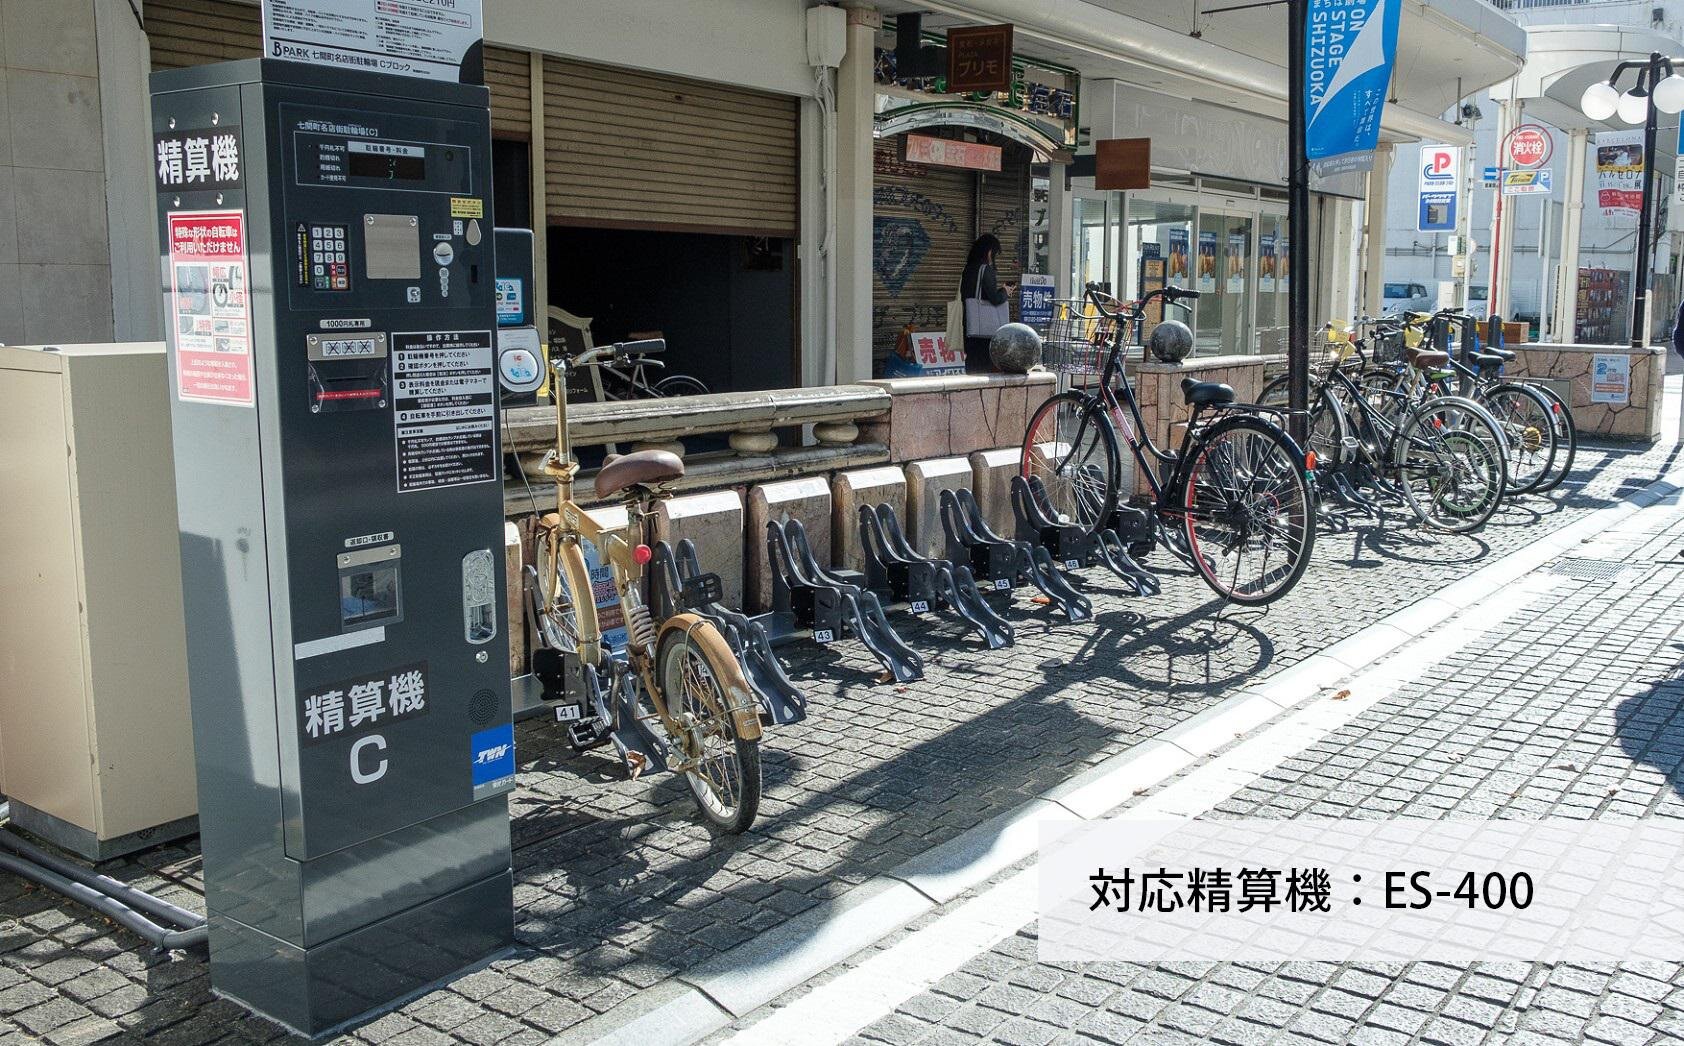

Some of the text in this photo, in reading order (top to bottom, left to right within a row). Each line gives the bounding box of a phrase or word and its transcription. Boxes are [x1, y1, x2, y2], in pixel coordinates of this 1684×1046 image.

[1350, 8, 1366, 31] ON
[1329, 10, 1346, 68] STAGE
[380, 60, 411, 72] Cブロック
[1310, 12, 1328, 105] SHIZUOKA
[1513, 141, 1543, 155] 消火栓
[158, 135, 240, 184] 精算機
[174, 241, 241, 254] ご利用いただけません
[918, 336, 967, 364] 売物
[997, 579, 1008, 588] 45
[914, 602, 926, 610] 44
[818, 631, 831, 640] 43
[304, 669, 426, 738] 精算機
[560, 707, 575, 718] 41
[349, 734, 389, 785] C
